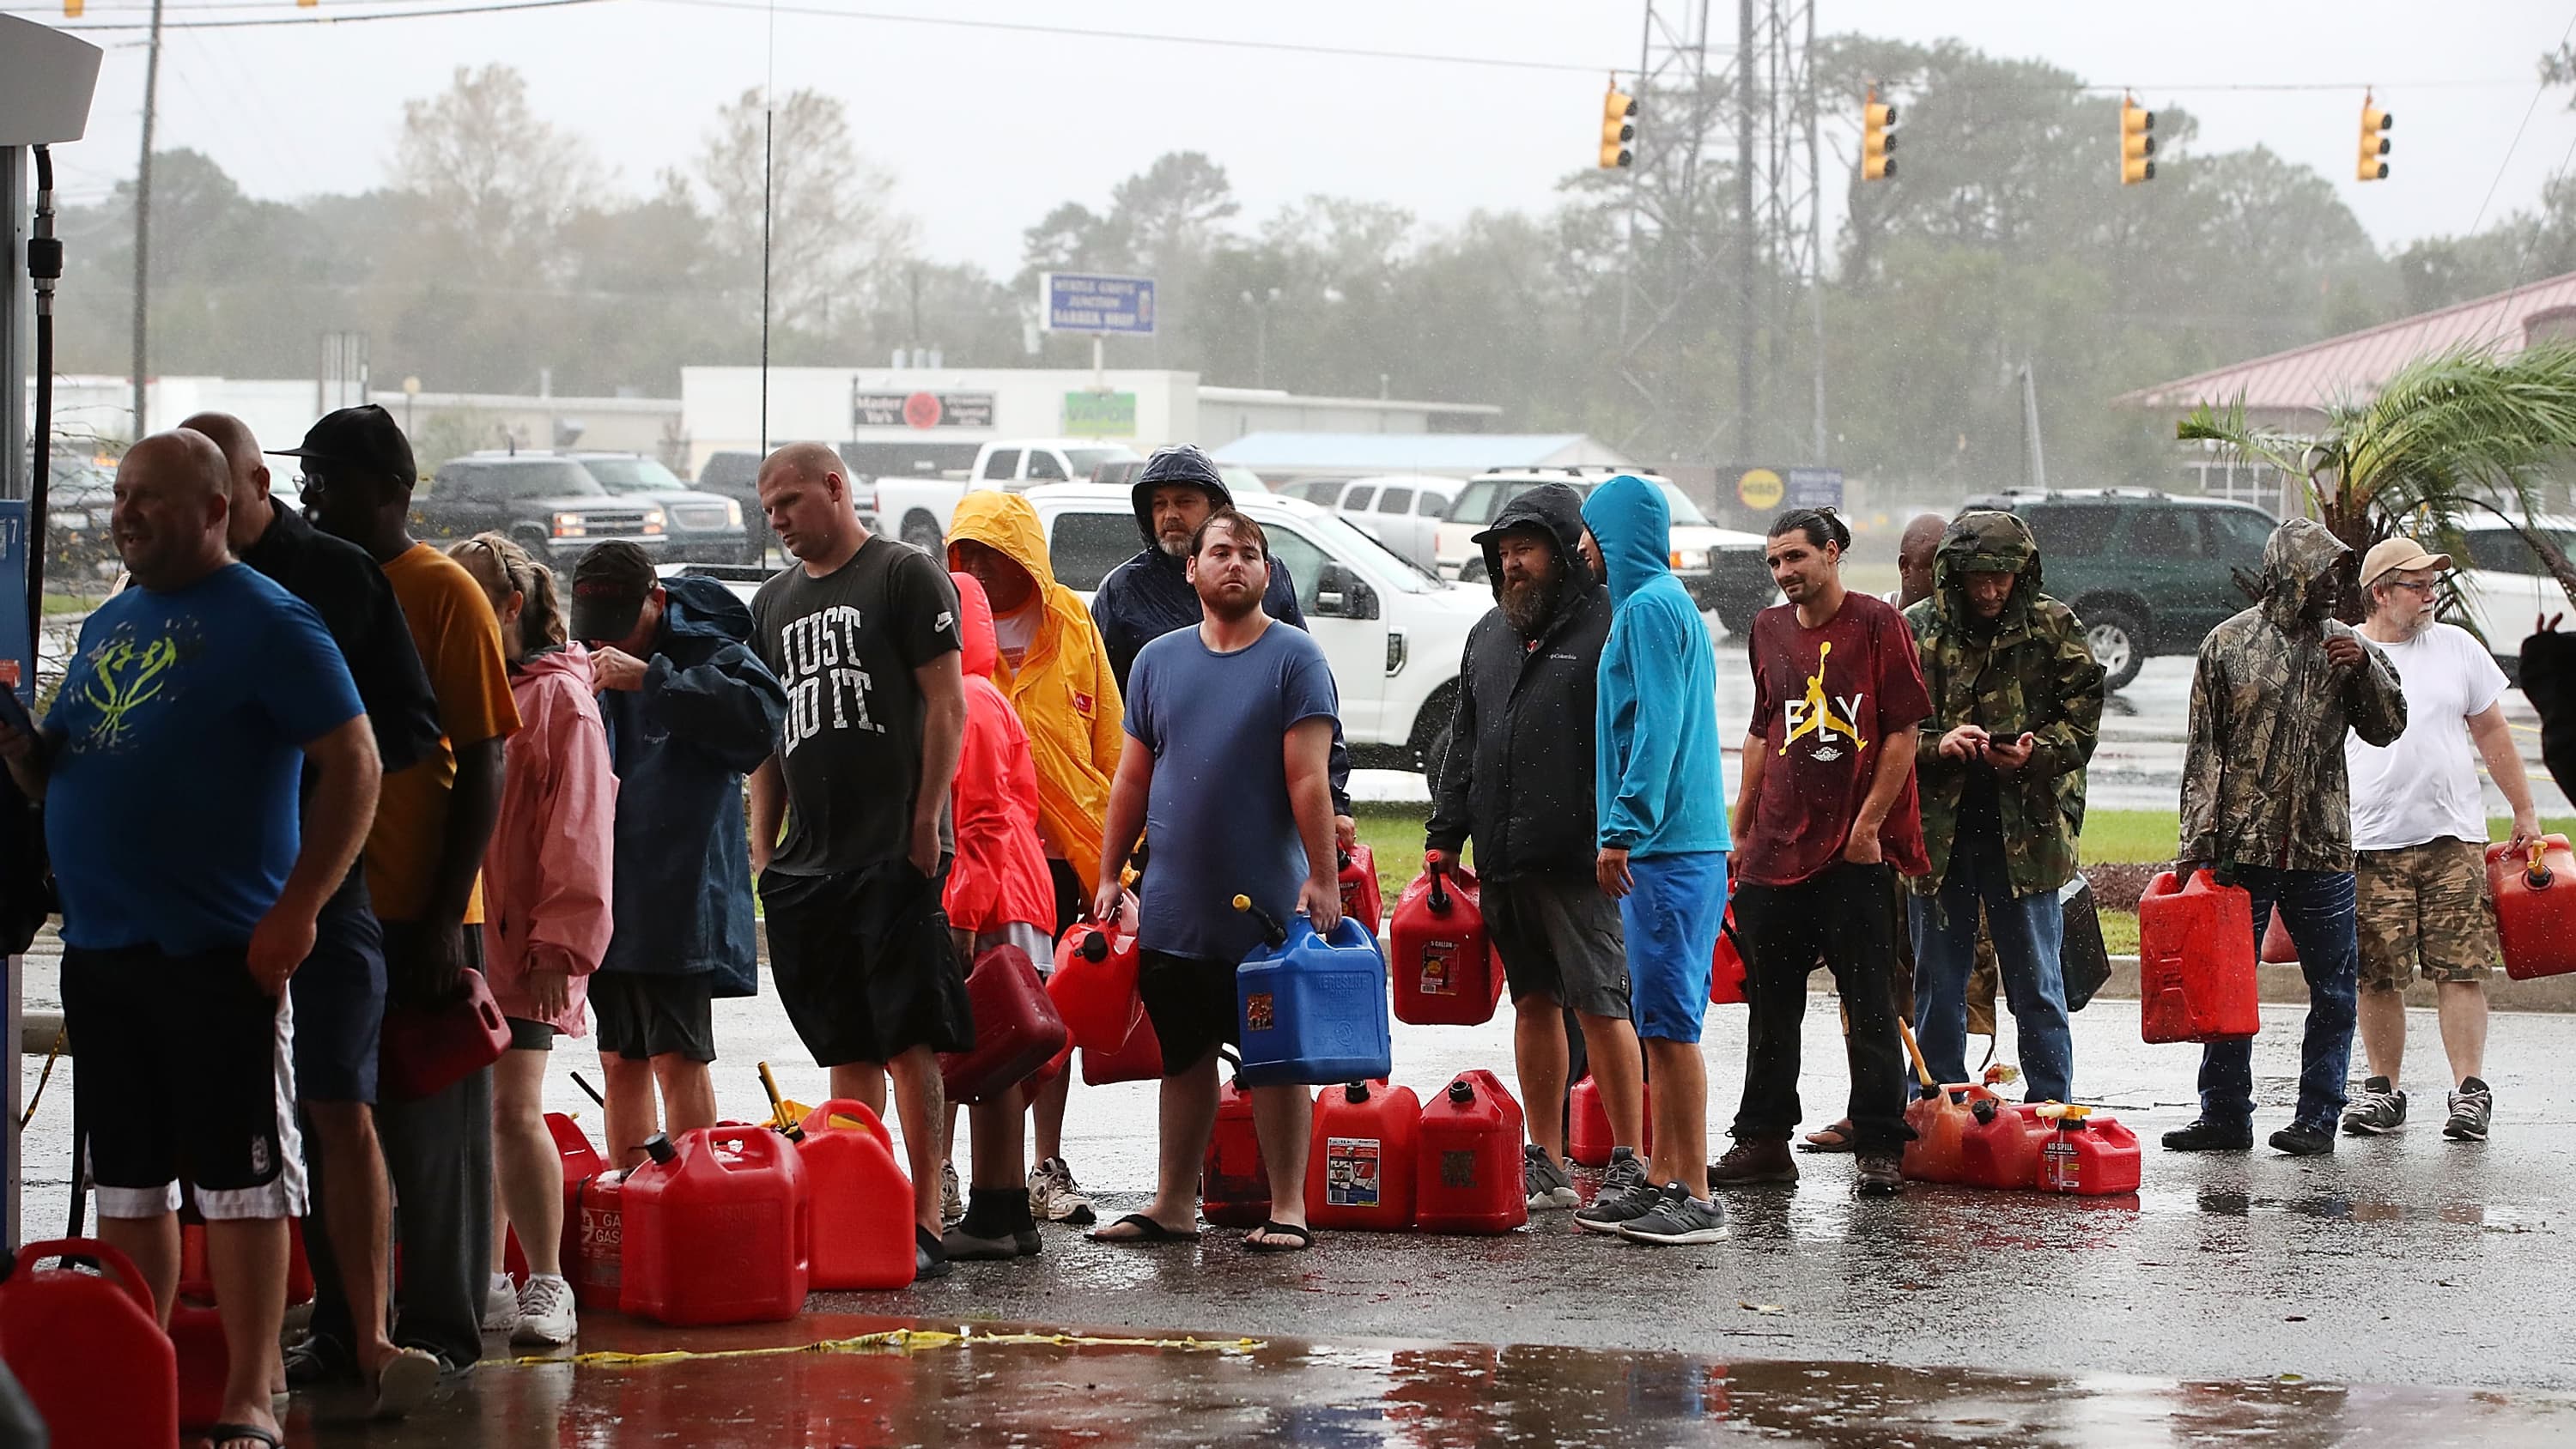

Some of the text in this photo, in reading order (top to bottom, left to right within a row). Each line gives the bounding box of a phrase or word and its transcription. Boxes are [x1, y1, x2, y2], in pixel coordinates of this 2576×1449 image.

[780, 605, 862, 688] JUST
[784, 667, 886, 758] DO IT.
[1784, 693, 1863, 746] FLY
[596, 1228, 623, 1244] GAS
